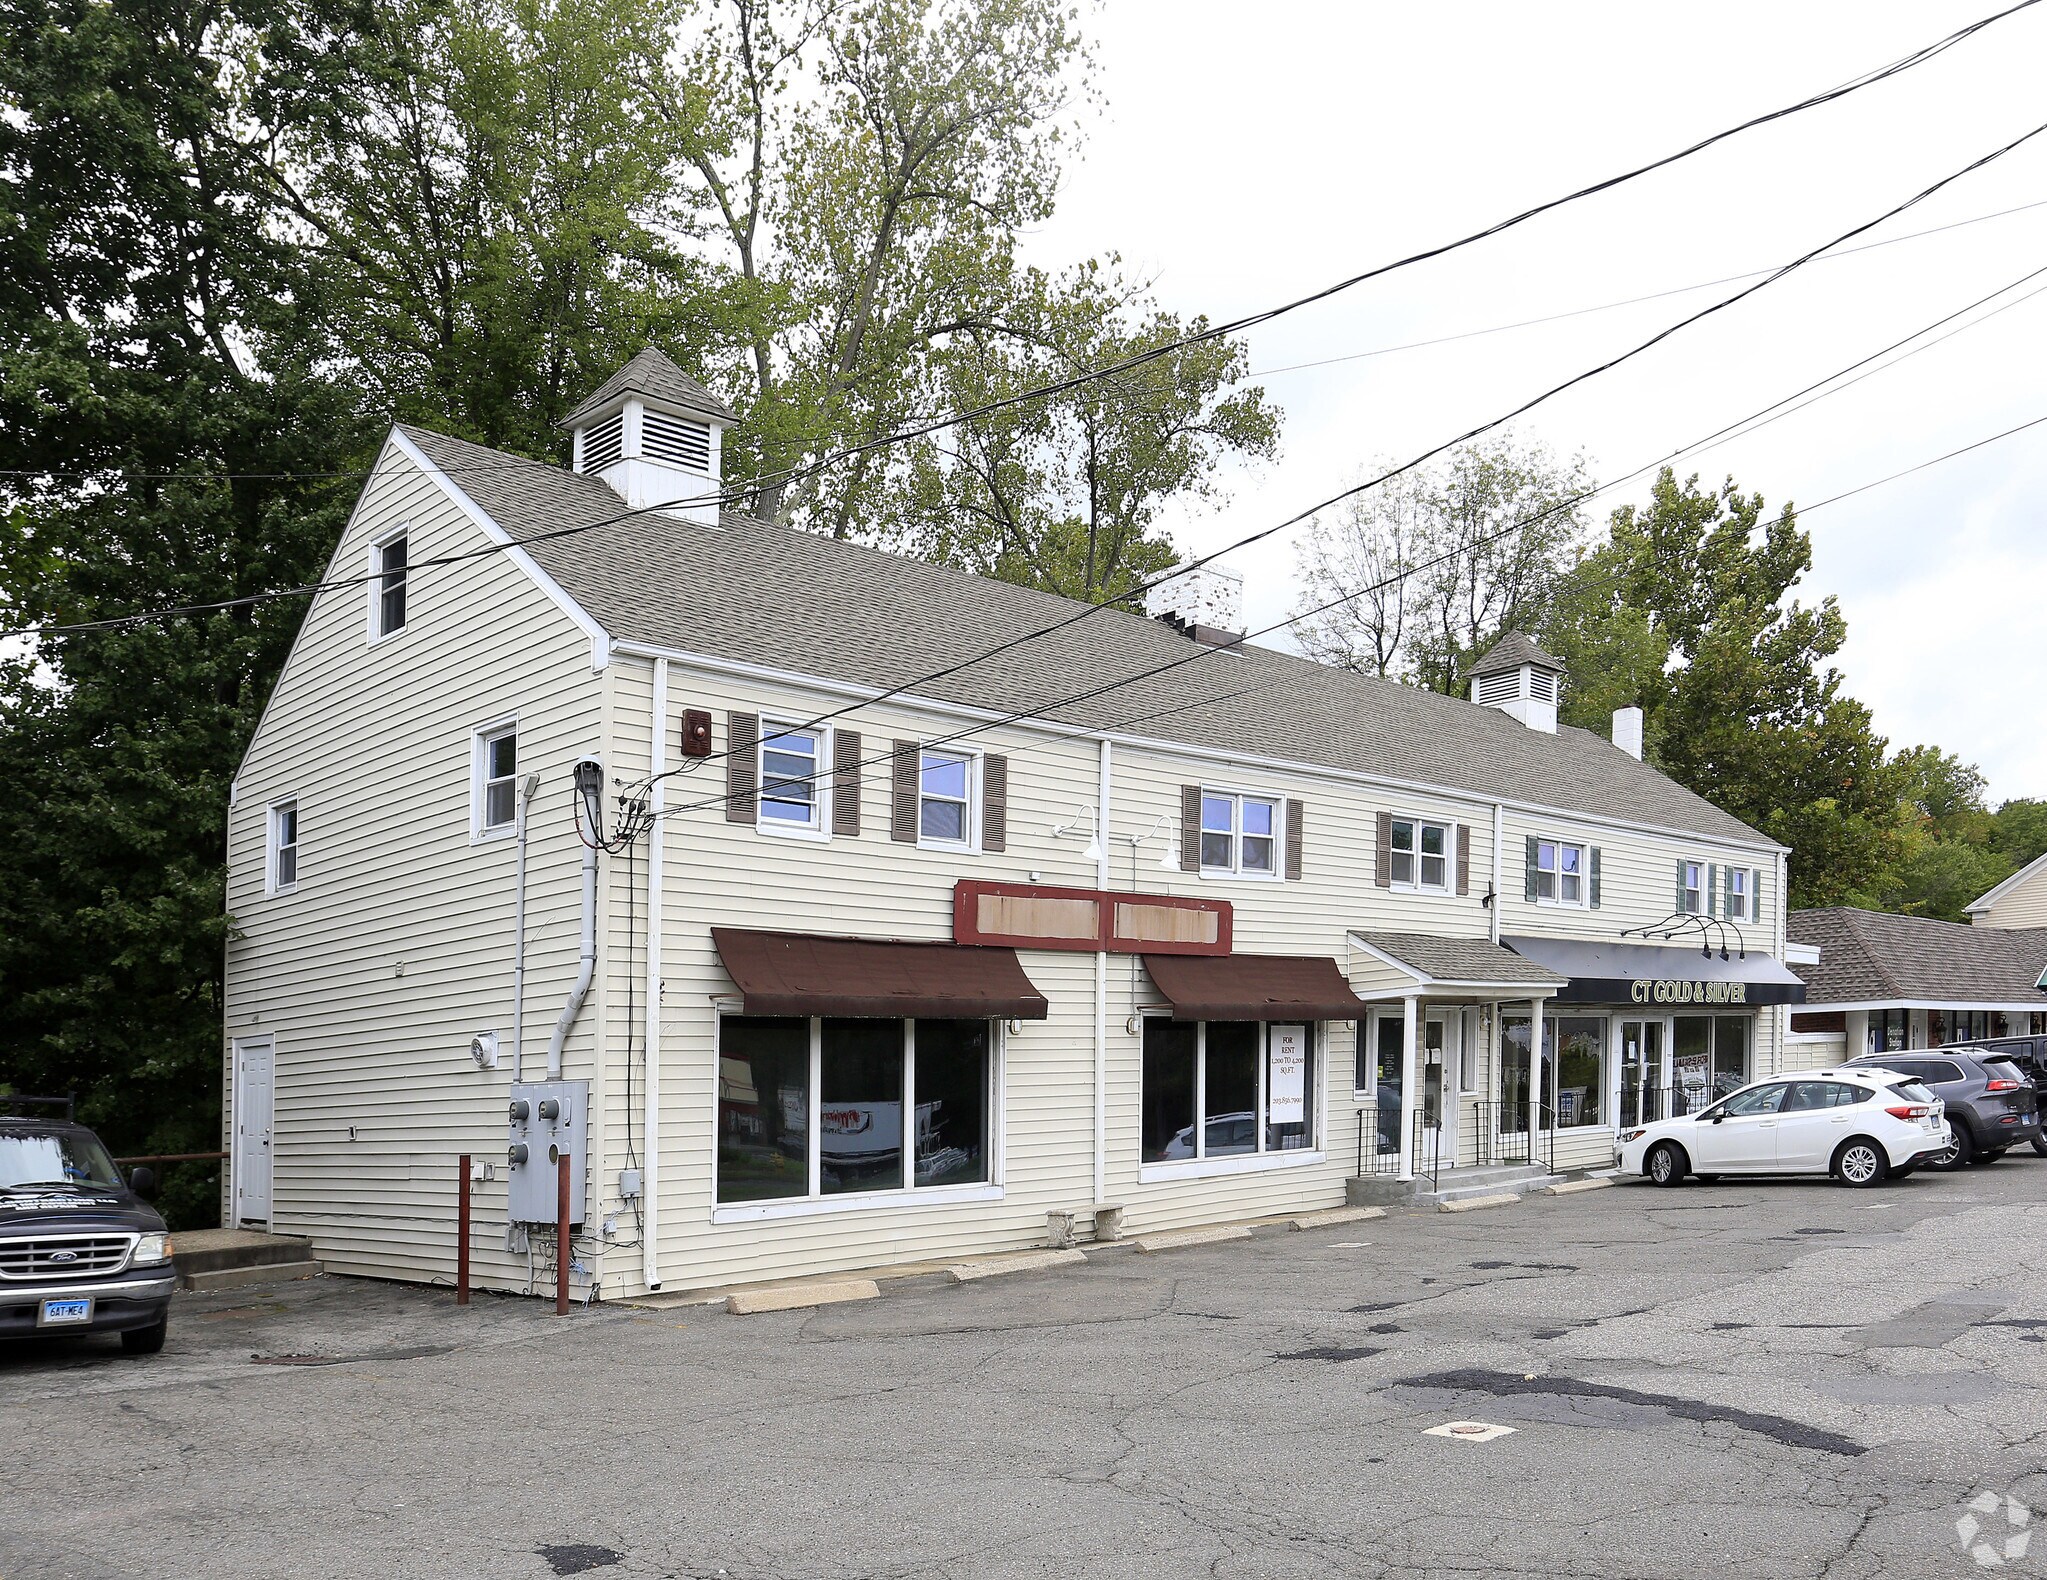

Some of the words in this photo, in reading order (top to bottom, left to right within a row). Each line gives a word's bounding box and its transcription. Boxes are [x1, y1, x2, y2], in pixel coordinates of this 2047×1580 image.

[1631, 980, 1651, 1002] CT
[1654, 981, 1692, 1002] GOLD
[1693, 982, 1704, 1002] &
[1705, 982, 1746, 1003] SILVER
